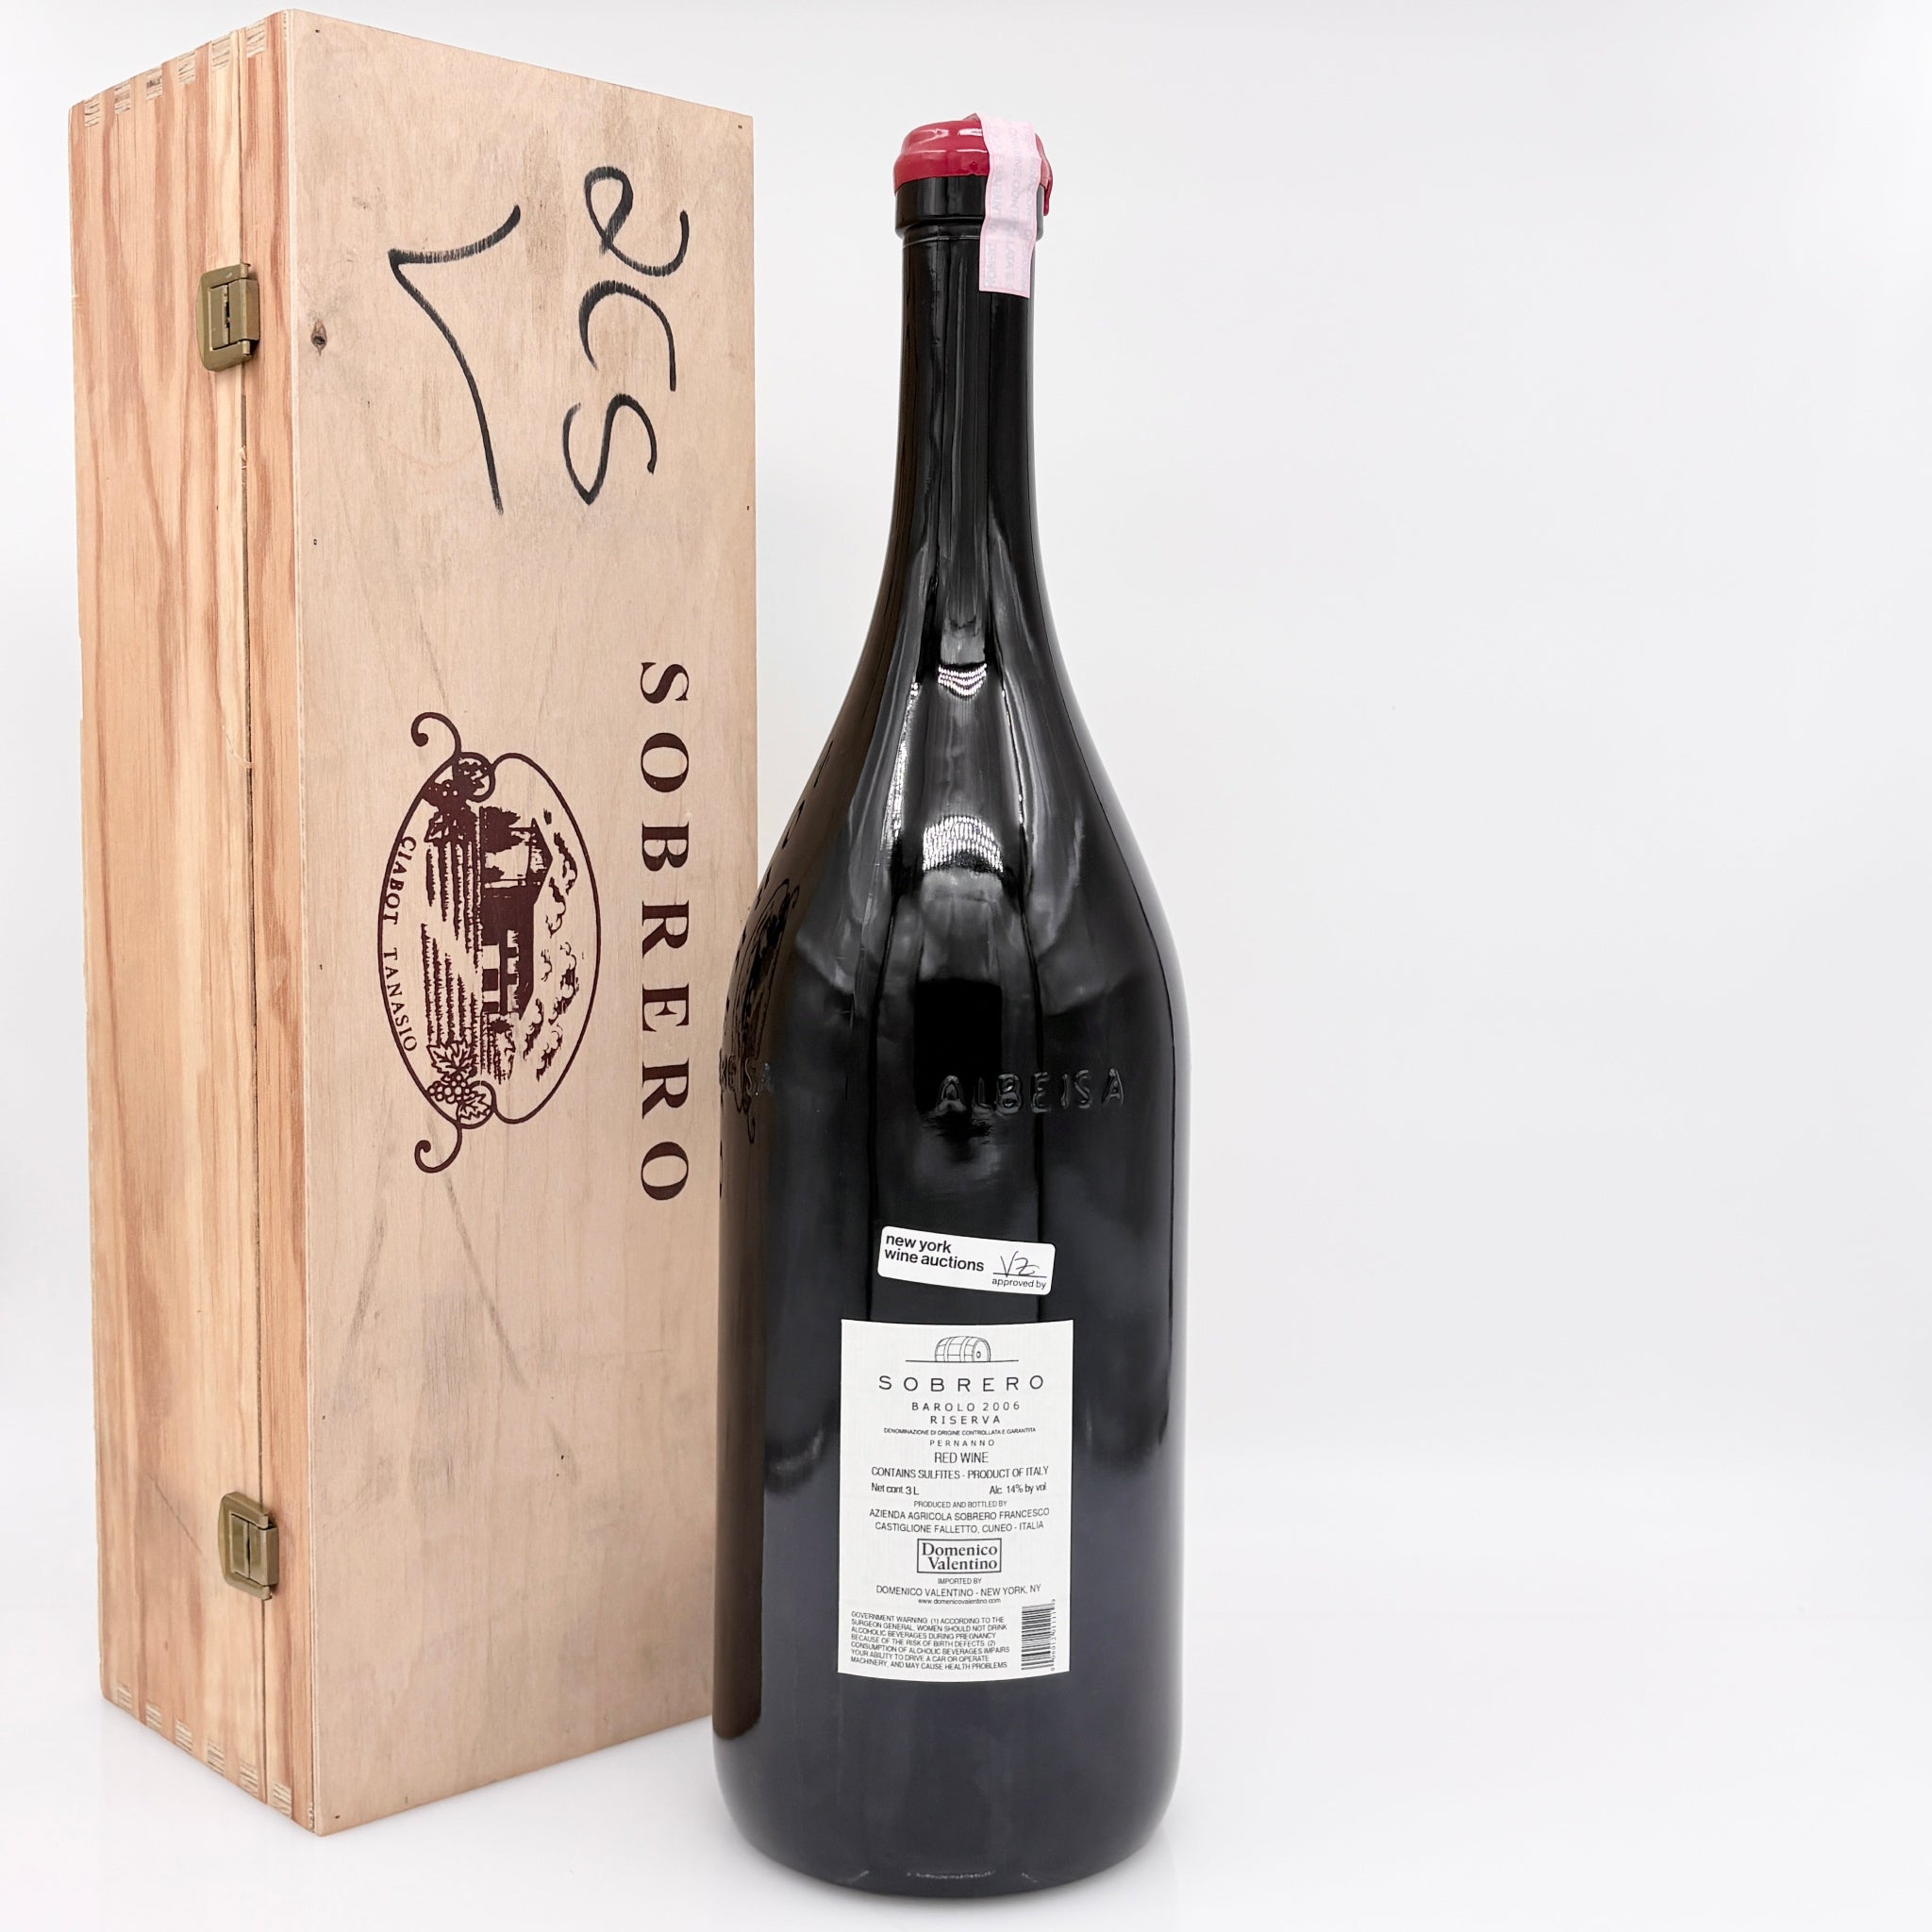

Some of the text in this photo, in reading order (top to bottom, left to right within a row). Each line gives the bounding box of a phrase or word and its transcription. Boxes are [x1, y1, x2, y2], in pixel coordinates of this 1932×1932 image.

[640, 662, 690, 1201] SOBRERO
[383, 835, 419, 1053] CIABOT TANASIO
[936, 1068, 1125, 1114] ALBEISA
[886, 1235, 952, 1253] new york
[885, 1248, 984, 1272] wine auctions
[992, 1278, 1046, 1290] approved by
[878, 1374, 1043, 1392] SOBRERO
[911, 1402, 1020, 1411] BAROLO 2006
[930, 1415, 1001, 1424] RISERVA
[935, 1452, 989, 1463] RED WINE
[872, 1467, 916, 1478] CONTAINS
[918, 1470, 959, 1478] SULFITES
[968, 1470, 1010, 1478] PRODUCT
[1012, 1468, 1024, 1476] OF
[1025, 1466, 1049, 1476] ITALY
[871, 1482, 885, 1492] Net
[906, 1486, 912, 1494] 3
[913, 1486, 919, 1495] L
[1007, 1484, 1024, 1493] 14%
[1024, 1483, 1034, 1494] by
[1036, 1482, 1046, 1491] vol
[869, 1508, 1050, 1521] AZIENDA AGRICOLA SOBRERO FRANCESCO
[875, 1522, 932, 1533] CASTIGLIONE
[982, 1523, 1012, 1533] CUNEO
[1019, 1521, 1044, 1531] ITALIA
[922, 1542, 997, 1557] Domenico
[928, 1557, 997, 1570] Valentino
[876, 1585, 923, 1596] DOMENICO
[924, 1587, 974, 1597] VALENTINO
[980, 1587, 1000, 1597] NEW
[1030, 1584, 1041, 1593] NY
[851, 1611, 895, 1622] GOVERNMENT
[851, 1618, 882, 1629] SURGEON
[888, 1630, 926, 1640] BEVERAGES
[851, 1641, 896, 1652] CONSUMPTION
[851, 1649, 869, 1657] YOUR
